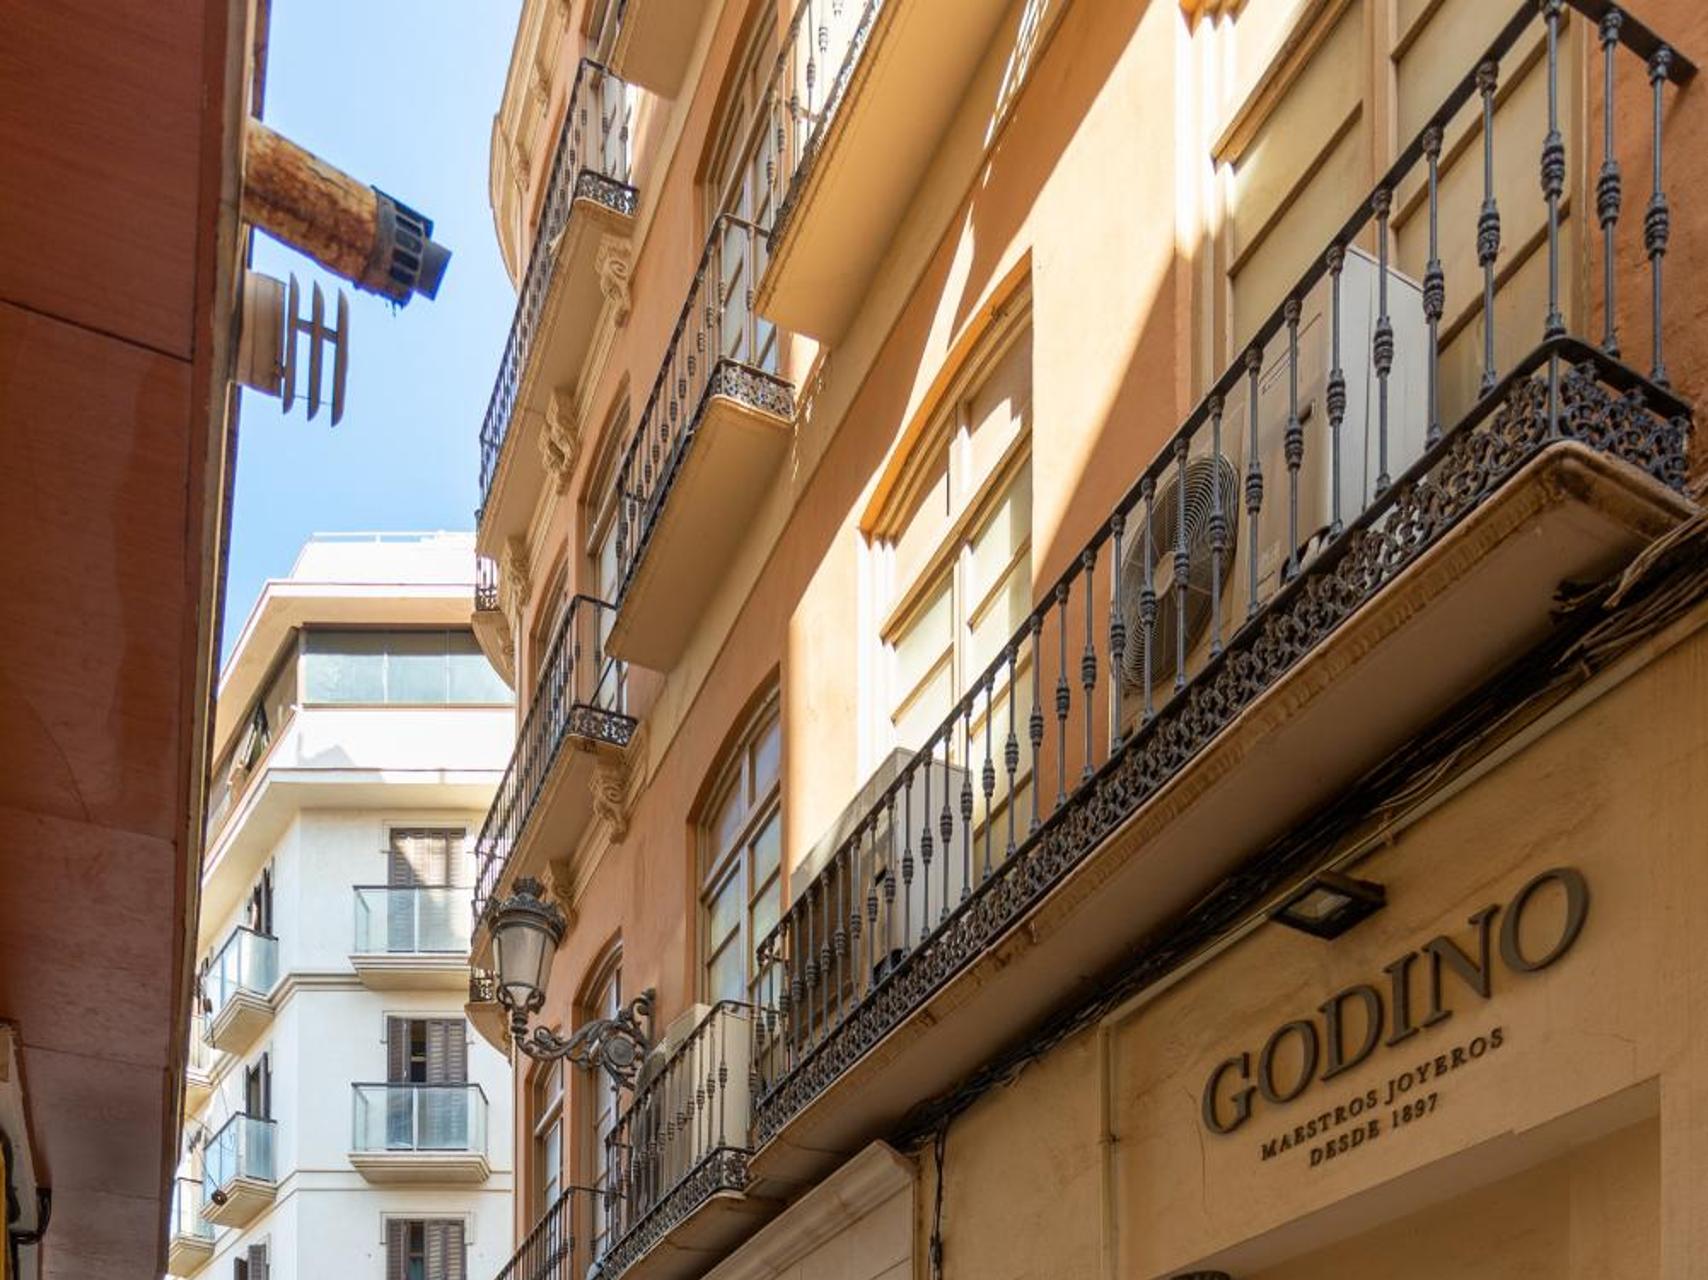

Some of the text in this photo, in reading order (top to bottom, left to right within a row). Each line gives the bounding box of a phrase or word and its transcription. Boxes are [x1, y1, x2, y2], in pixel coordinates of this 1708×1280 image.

[1202, 867, 1590, 1136] GODINO
[1260, 1026, 1505, 1161] MAESTROS JOYEROS
[1308, 1093, 1439, 1168] DESDE 1897
